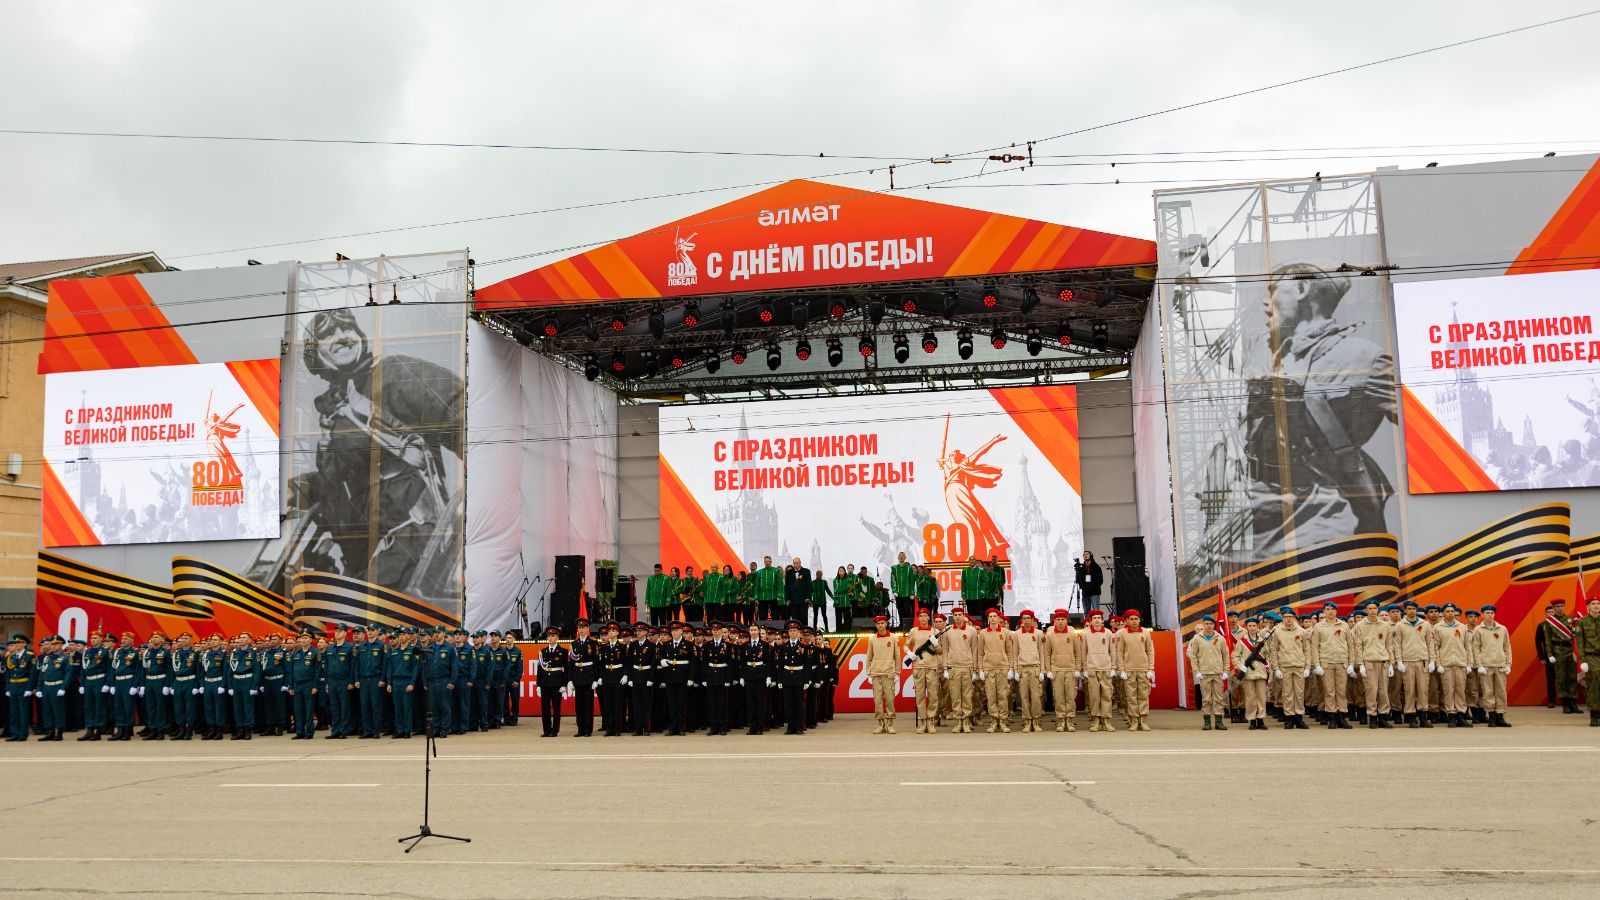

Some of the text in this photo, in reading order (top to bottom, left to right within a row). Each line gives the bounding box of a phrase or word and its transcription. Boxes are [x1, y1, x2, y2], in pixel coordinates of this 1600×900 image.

[668, 262, 685, 278] 80
[706, 236, 934, 281] С ДНЁМ ПОБЕДЫ!
[668, 276, 698, 287] ПОБЕДА!
[1429, 315, 1592, 344] С ПРАЗДНИКОМ
[1431, 343, 1526, 369] ВЕЛИКОЙ
[65, 403, 173, 425] С ПРАЗДНИКОМ
[65, 423, 195, 446] ВЕЛИКОЙ ПОБЕДЫ!
[714, 433, 878, 464] С ПРАЗДНИКОМ
[192, 461, 220, 488] 80
[714, 461, 914, 491] ВЕЛИКОЙ ПОБЕДЫ!
[192, 490, 244, 507] ПОБЕДА!
[923, 523, 969, 563] 80
